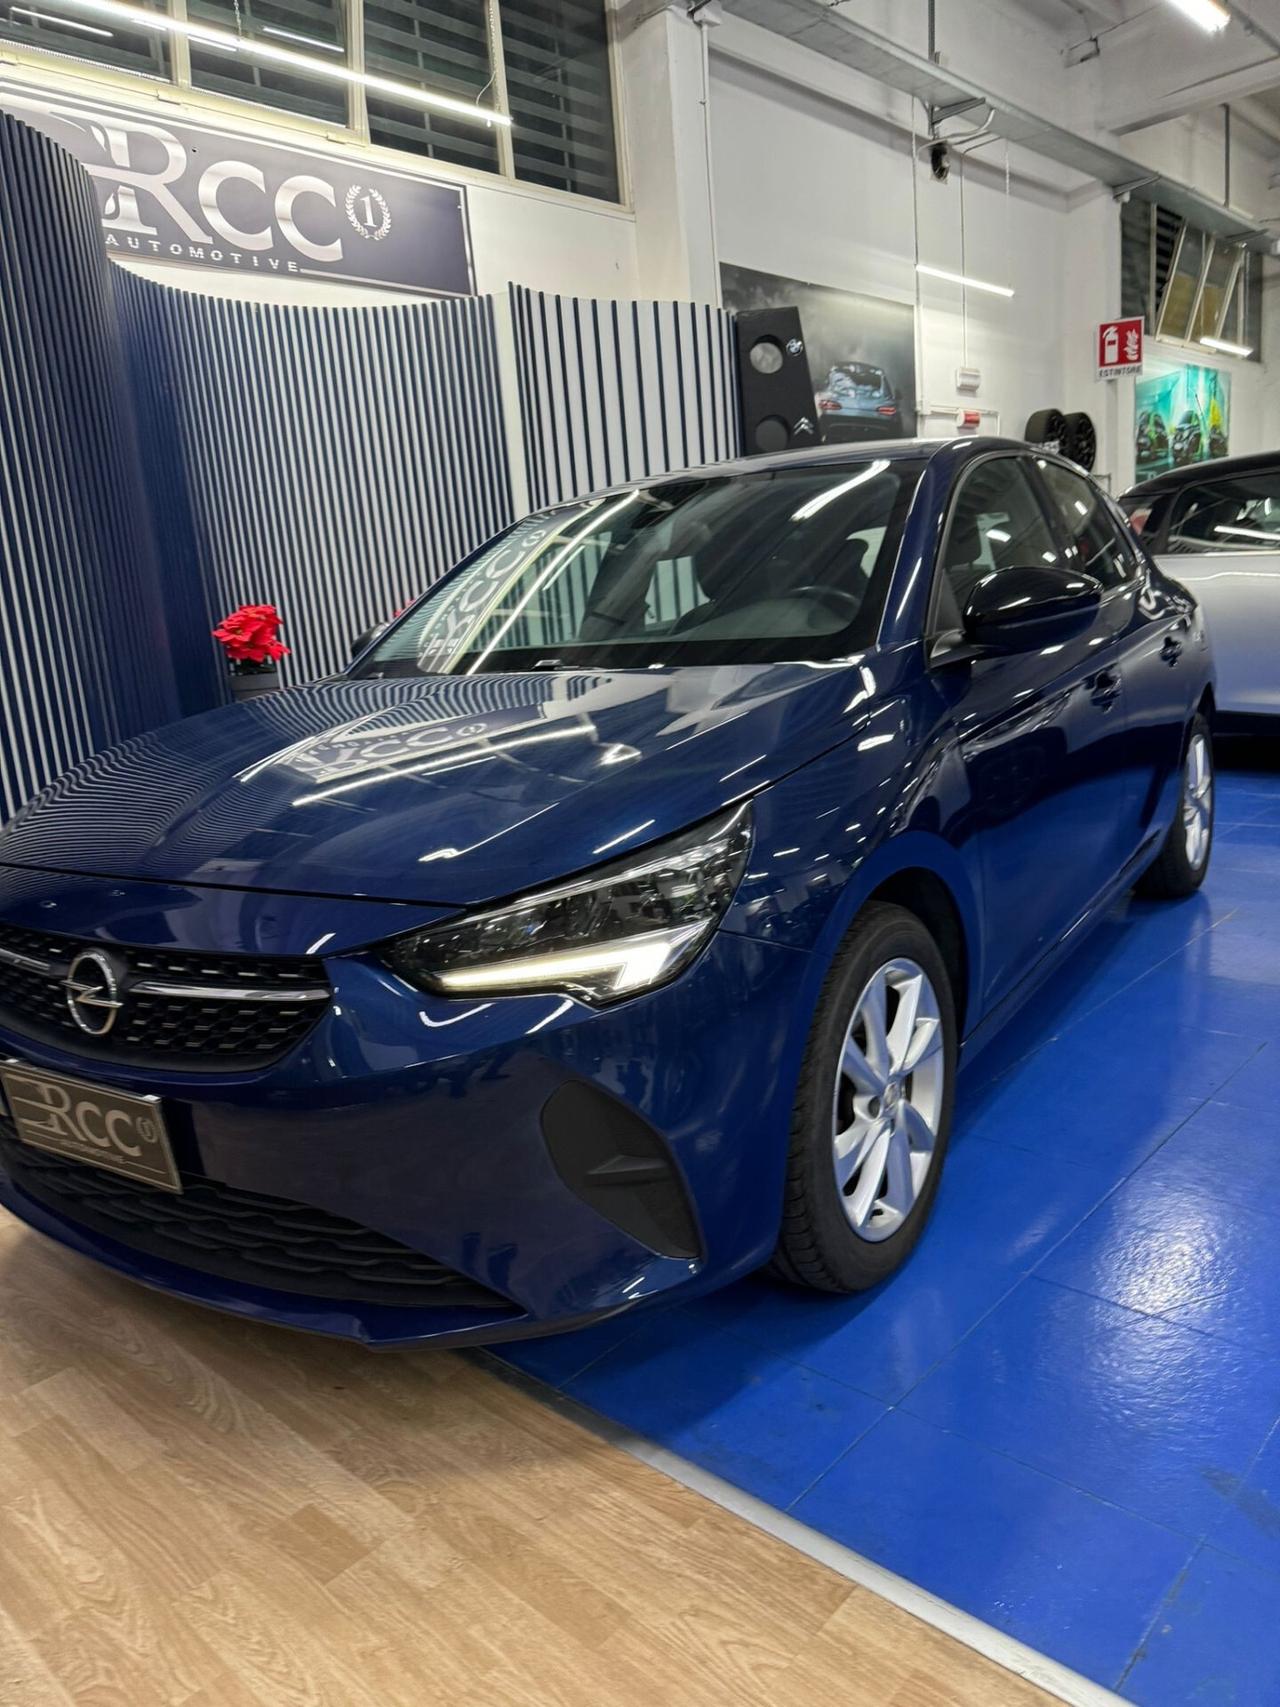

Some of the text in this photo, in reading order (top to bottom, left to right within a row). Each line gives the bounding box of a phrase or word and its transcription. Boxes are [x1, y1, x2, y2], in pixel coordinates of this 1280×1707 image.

[84, 111, 344, 262] RCC
[104, 233, 301, 273] AUTOMOTIVE
[1099, 364, 1142, 377] ESTINTORE
[18, 1077, 142, 1158] RCC
